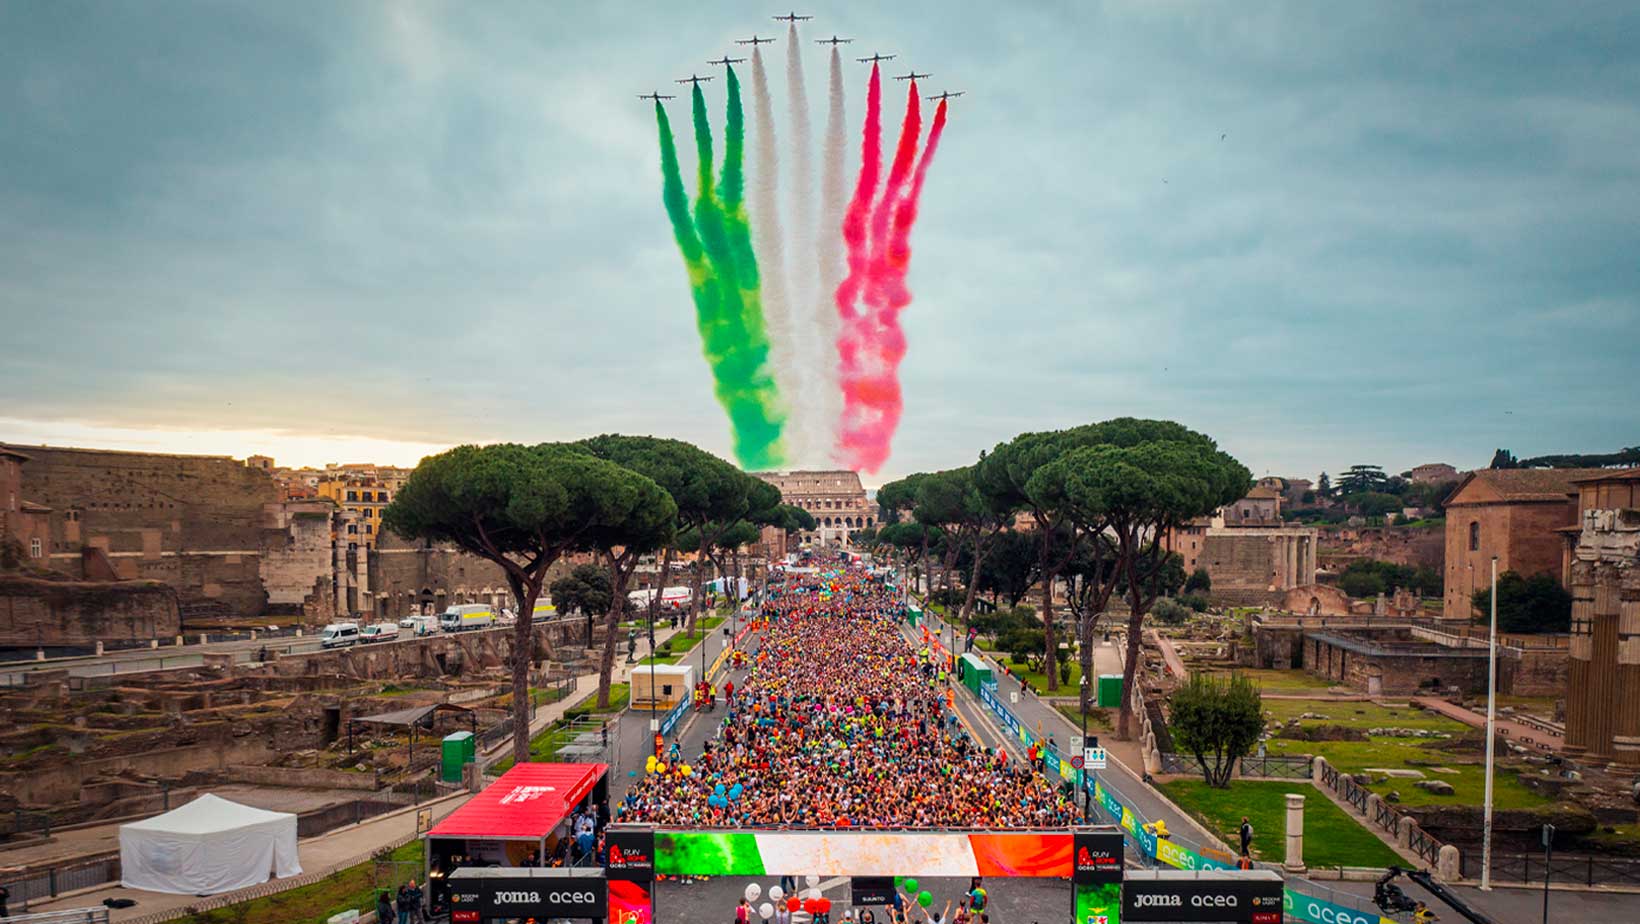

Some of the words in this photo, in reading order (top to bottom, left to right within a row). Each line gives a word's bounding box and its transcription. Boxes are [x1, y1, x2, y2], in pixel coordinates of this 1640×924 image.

[1162, 845, 1195, 869] acea
[549, 891, 596, 903] acea
[1191, 895, 1238, 907] acea
